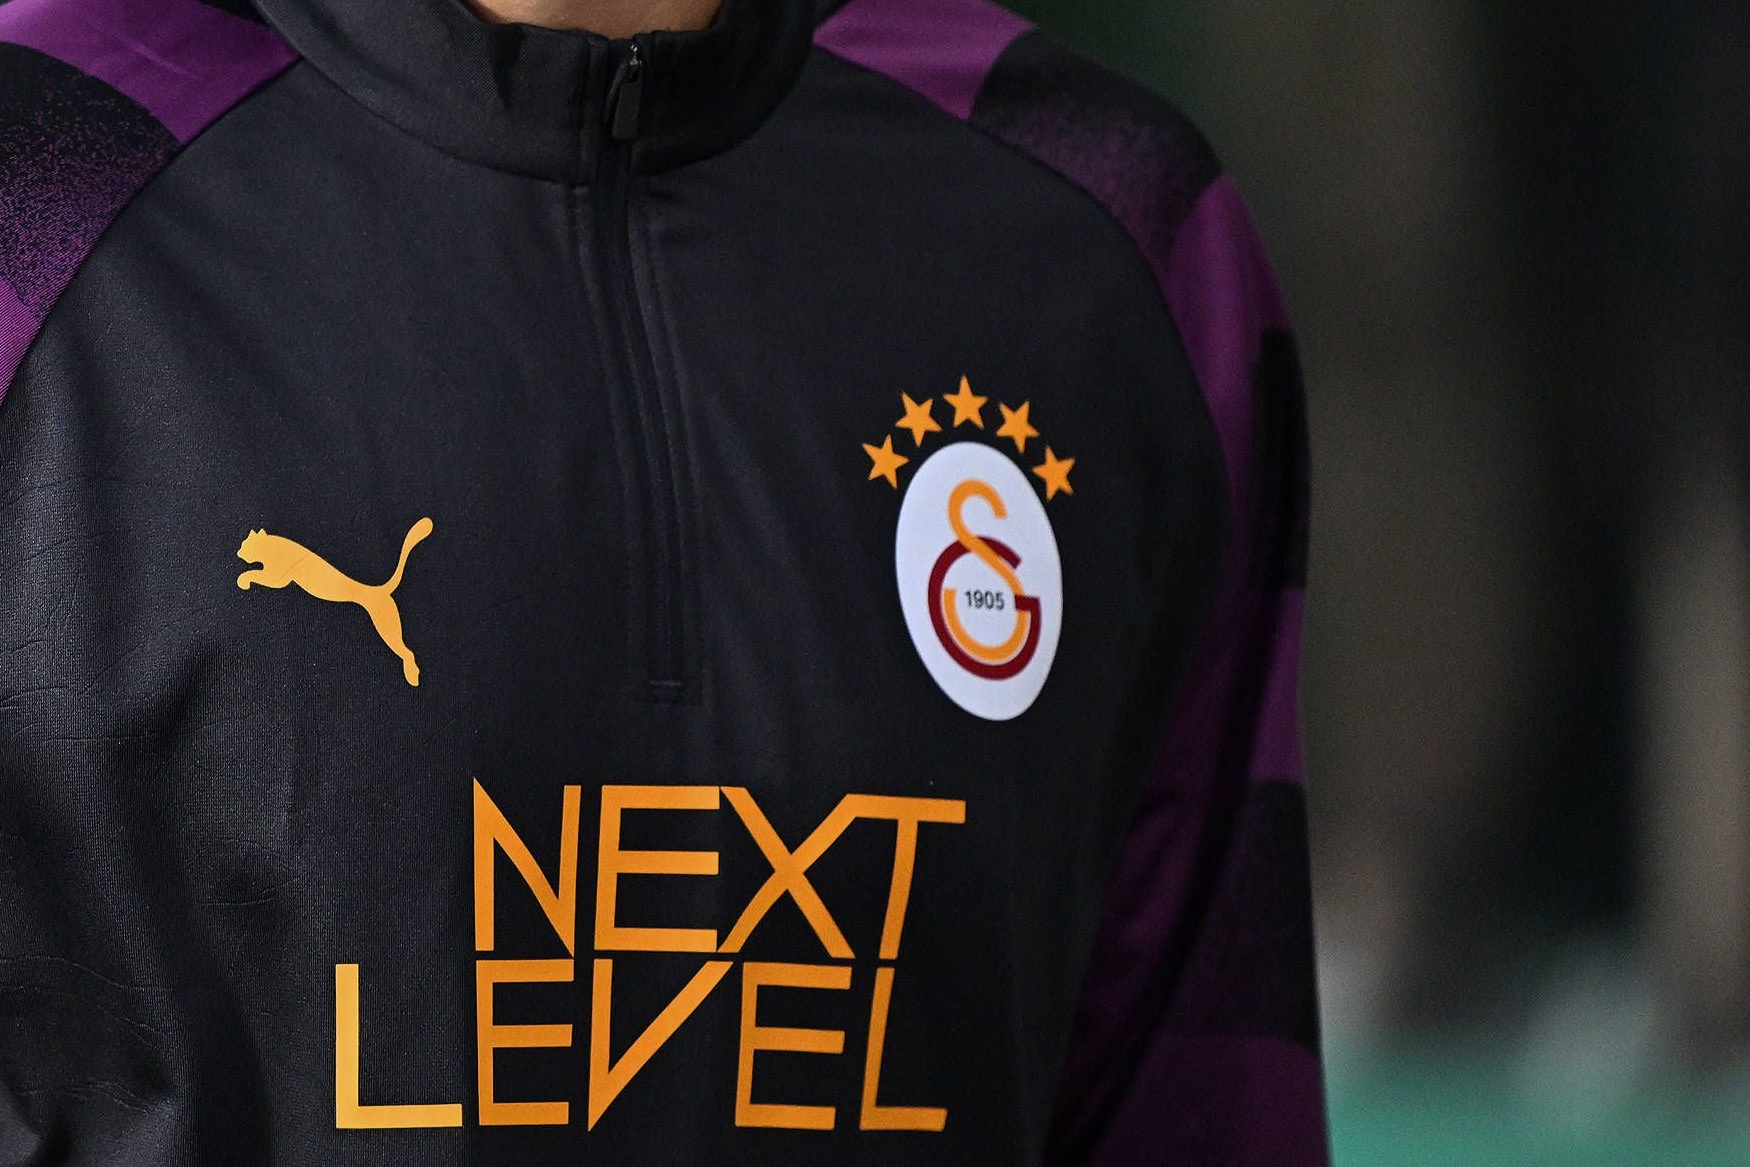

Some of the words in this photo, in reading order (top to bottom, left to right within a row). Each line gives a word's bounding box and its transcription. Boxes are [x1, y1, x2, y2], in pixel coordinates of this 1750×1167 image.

[964, 590, 1005, 611] 1905
[473, 778, 966, 959] NEXT
[335, 958, 948, 1132] LEVEL
